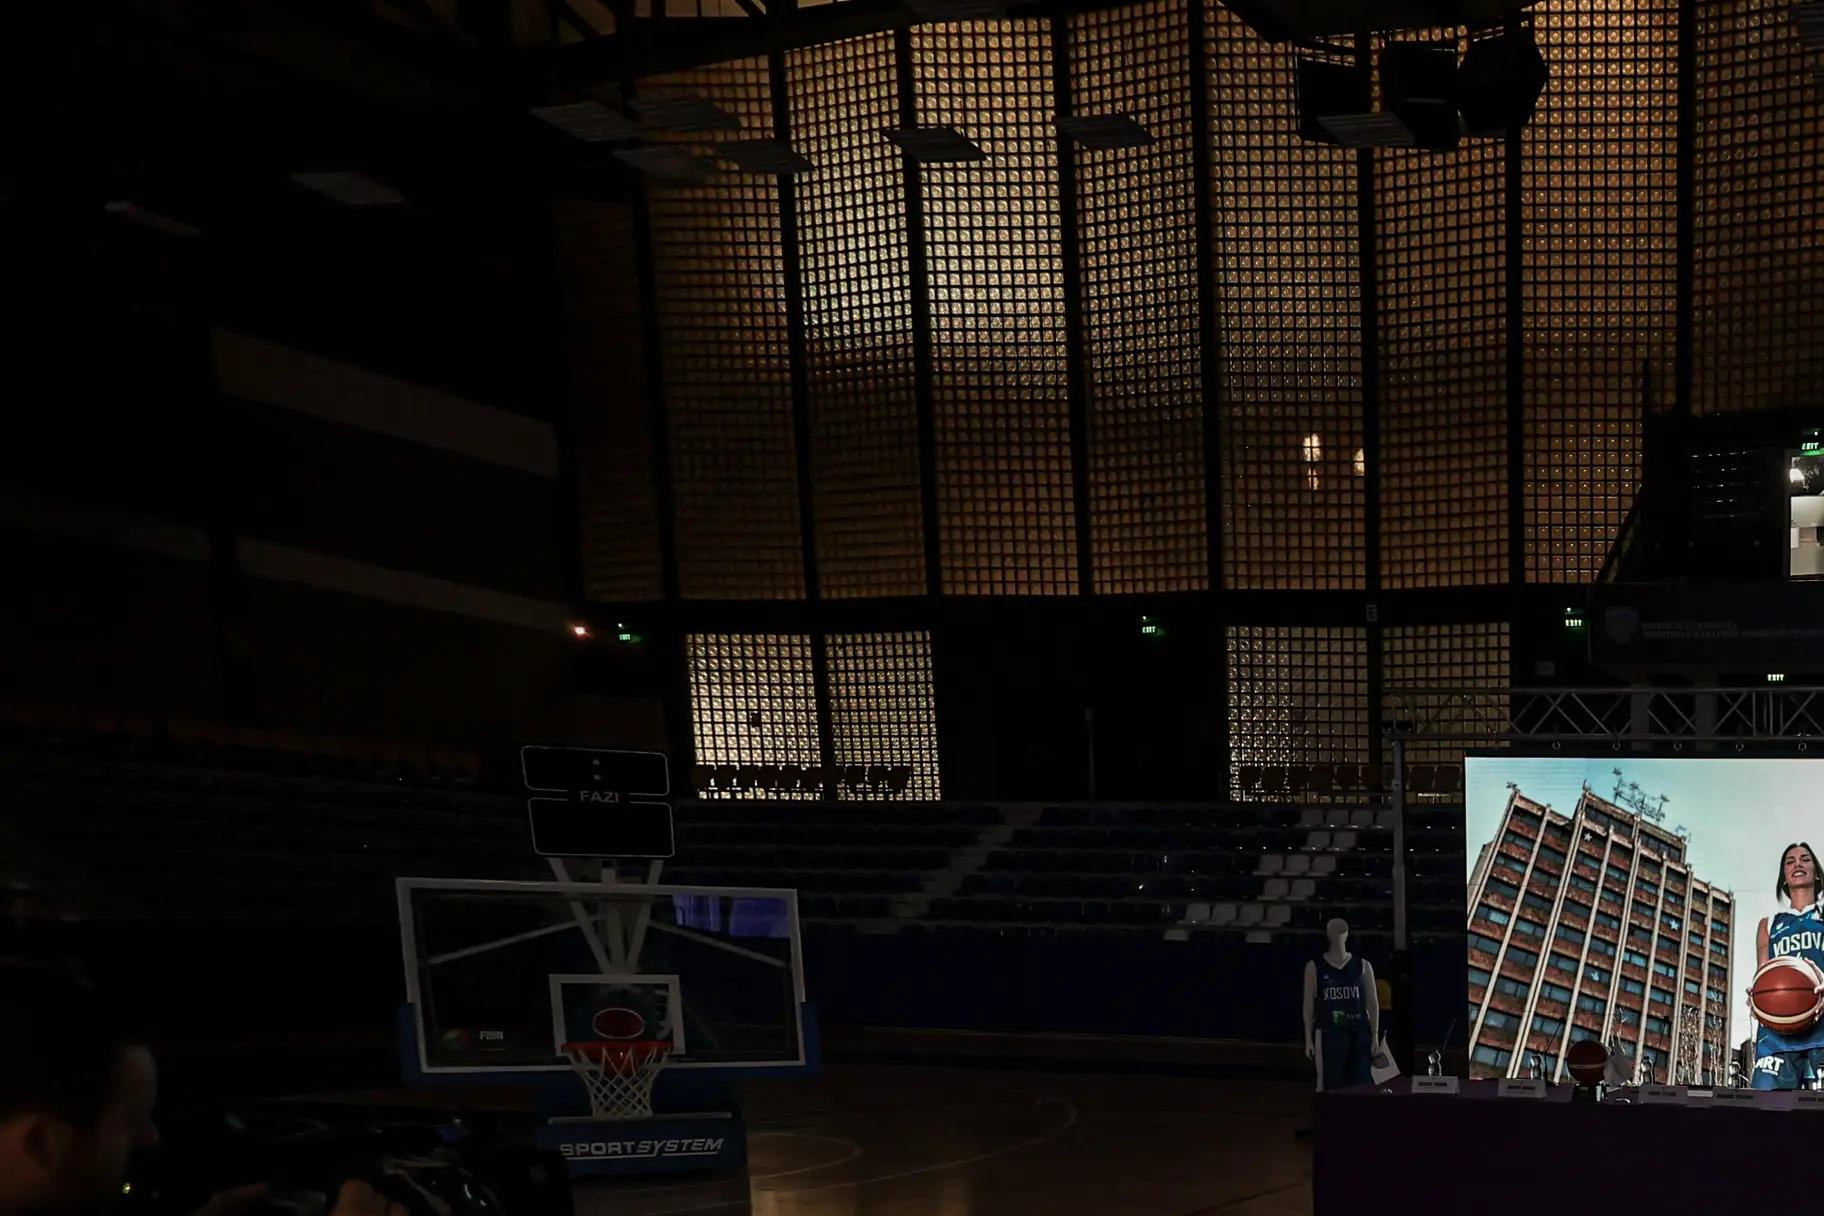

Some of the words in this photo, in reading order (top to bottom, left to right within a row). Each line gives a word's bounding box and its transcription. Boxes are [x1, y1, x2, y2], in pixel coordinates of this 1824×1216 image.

[1801, 441, 1820, 451] EXIT
[1565, 619, 1583, 627] EXIT
[1767, 673, 1785, 682] EXIT
[579, 790, 620, 803] FAZI
